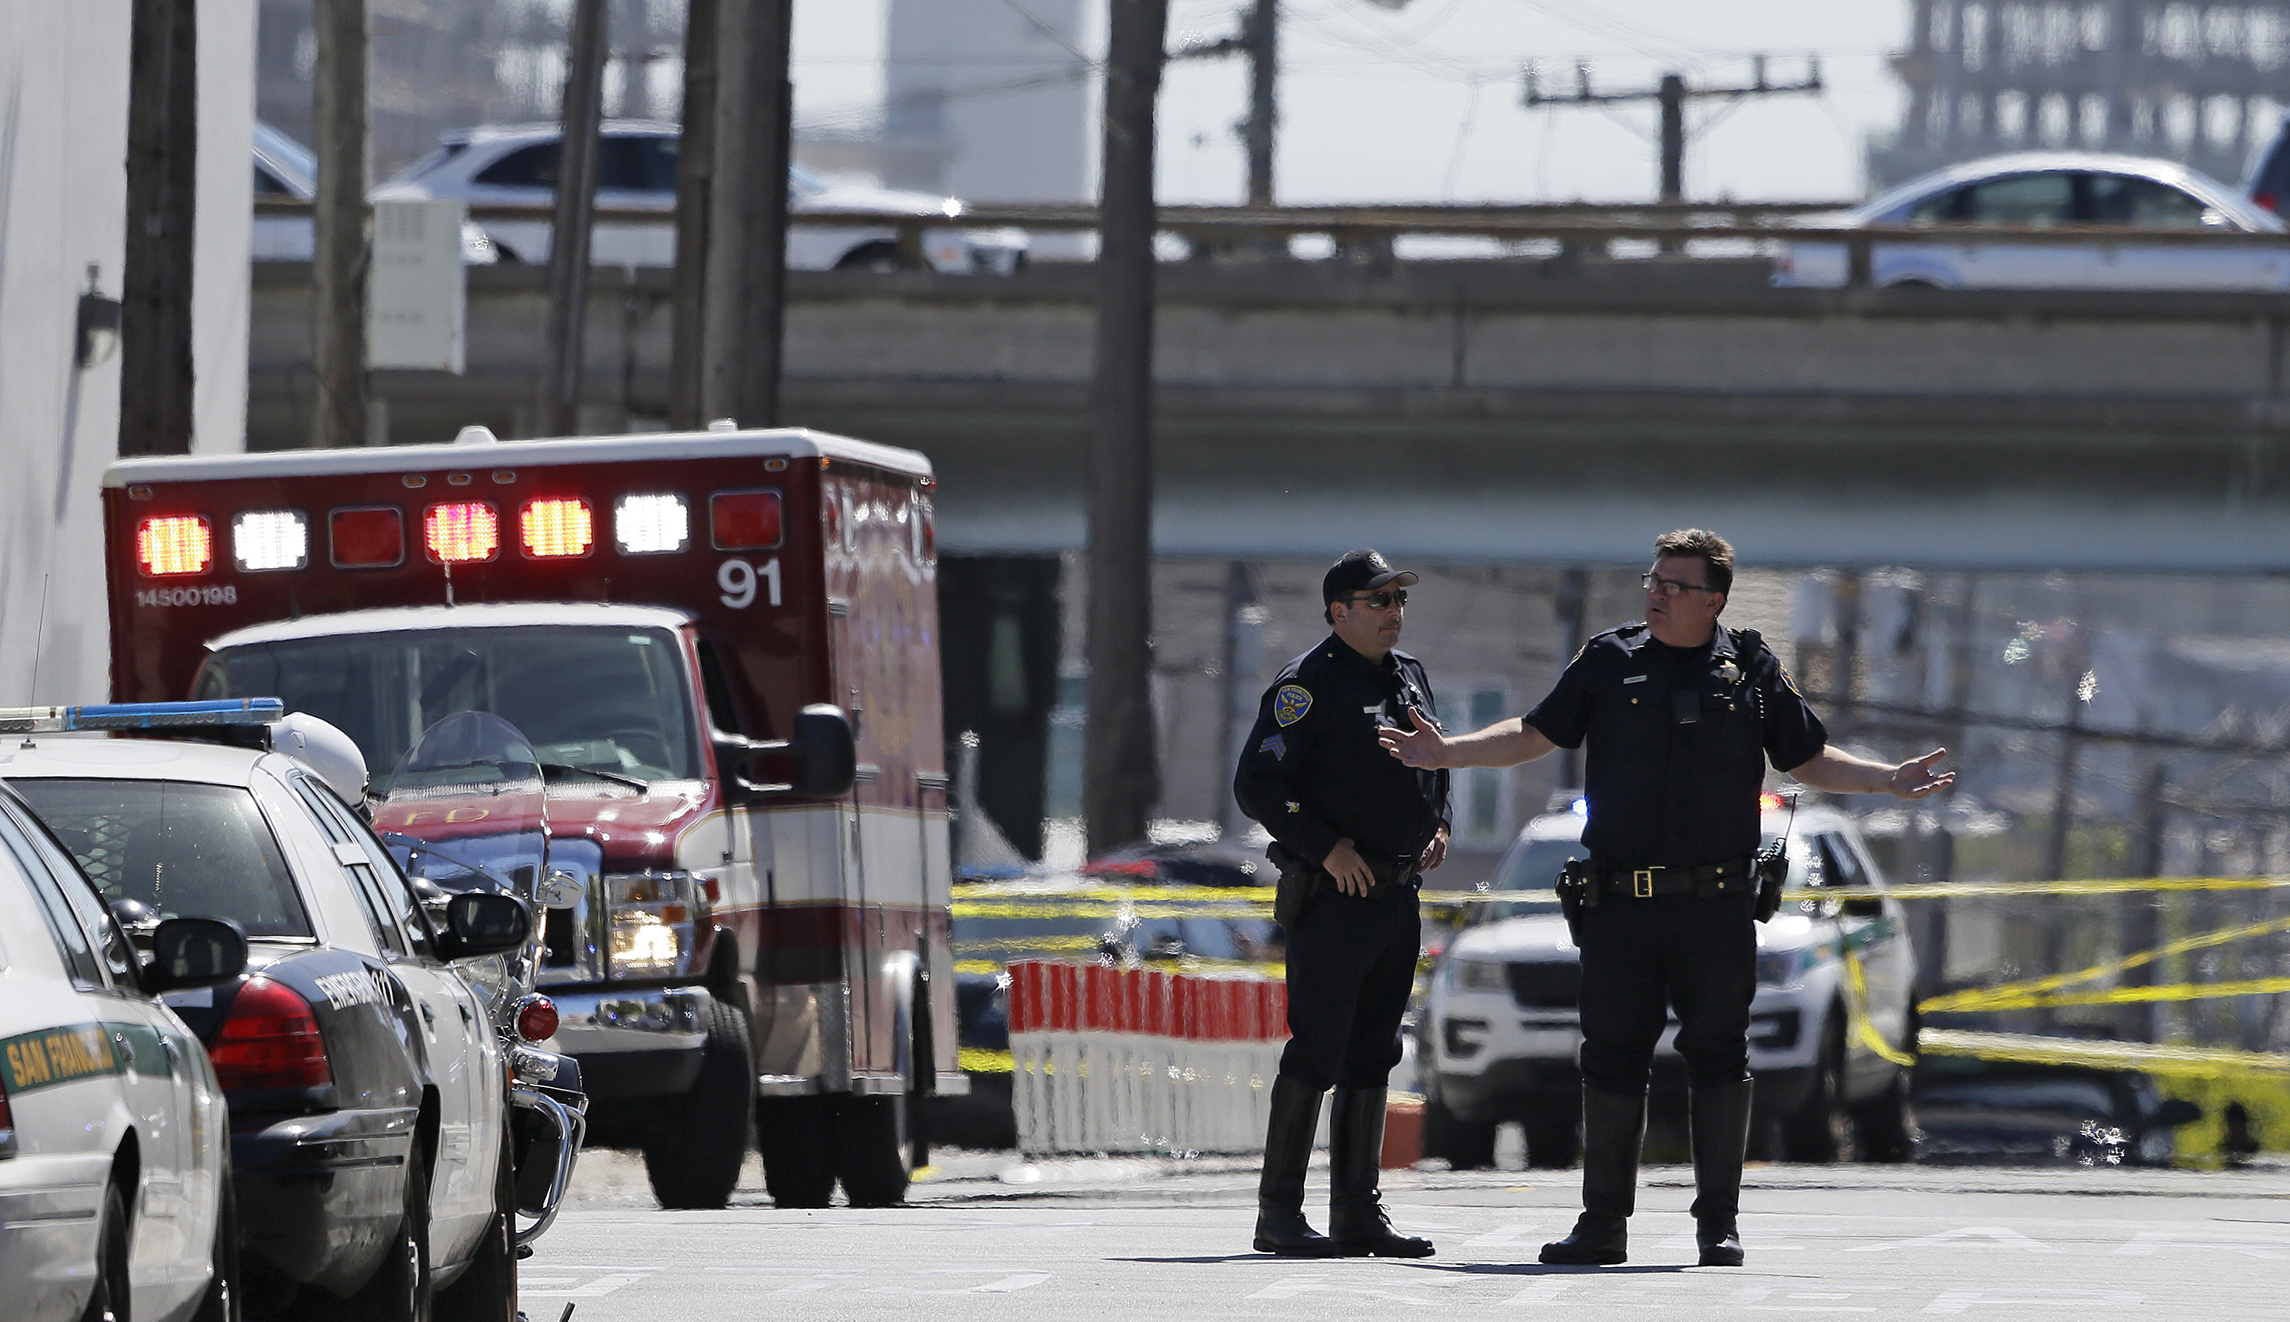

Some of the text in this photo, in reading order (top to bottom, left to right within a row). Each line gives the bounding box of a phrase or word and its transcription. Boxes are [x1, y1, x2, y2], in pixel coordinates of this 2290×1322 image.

[136, 587, 236, 607] 14500198
[718, 558, 782, 609] 91
[7, 1039, 51, 1087] SAN
